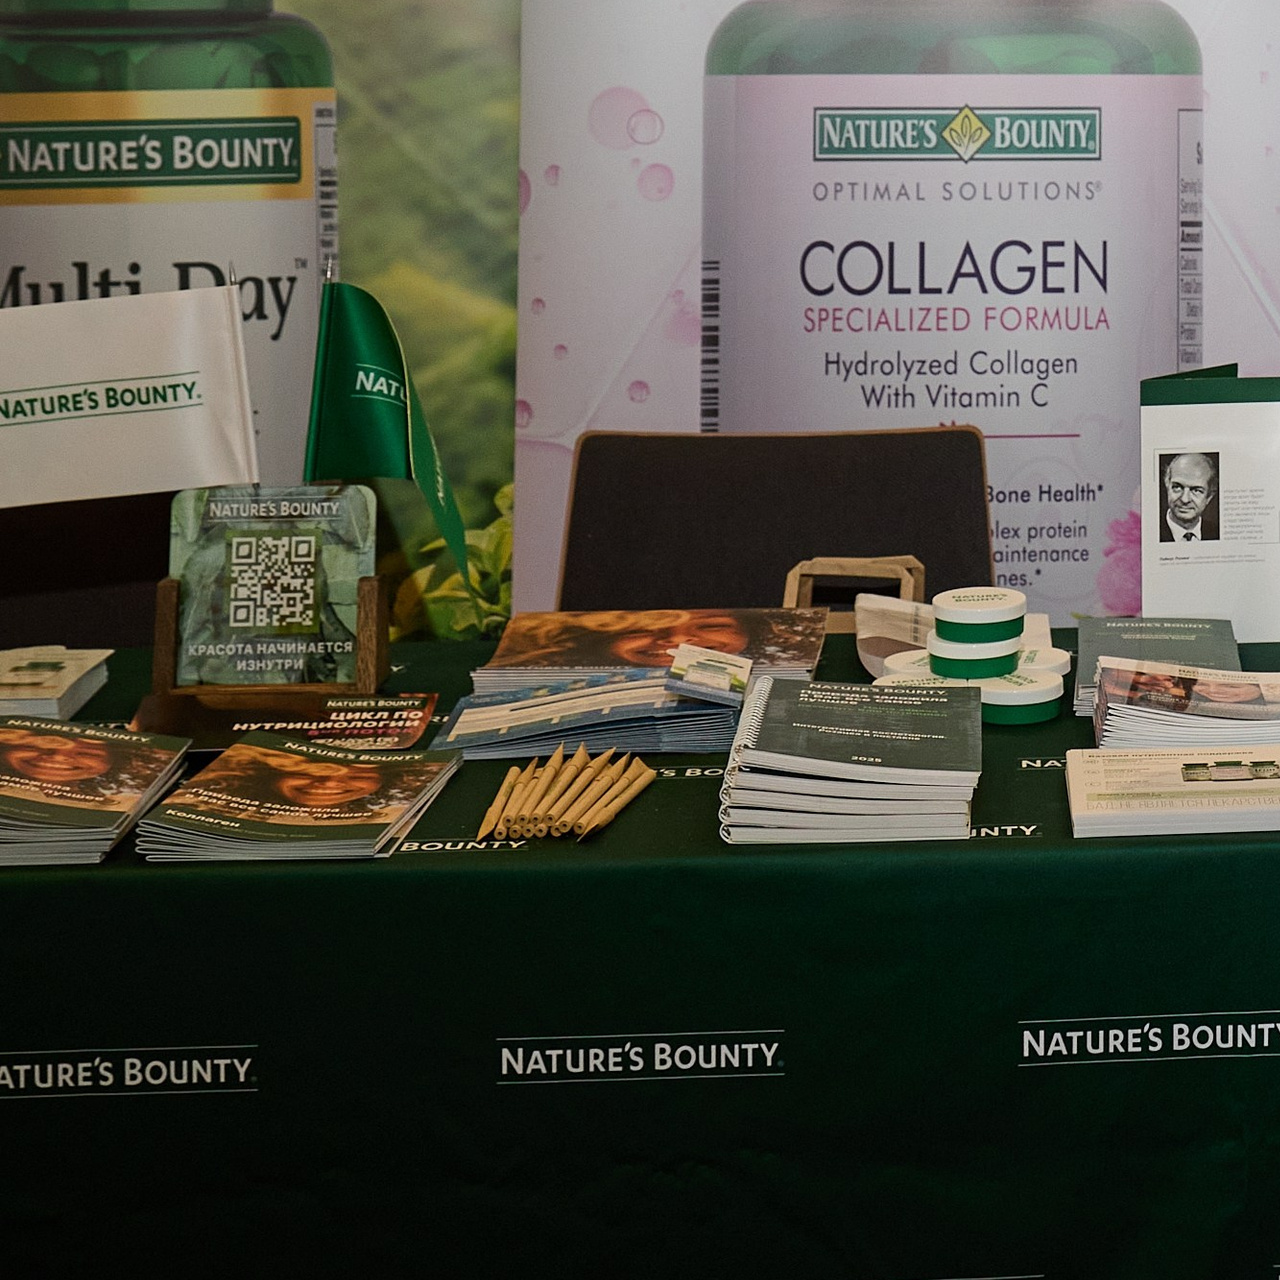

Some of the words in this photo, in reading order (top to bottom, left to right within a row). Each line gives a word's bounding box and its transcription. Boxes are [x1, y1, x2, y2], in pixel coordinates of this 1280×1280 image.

[822, 117, 938, 149] NATURE'S
[8, 134, 162, 173] NATURE'S
[813, 181, 926, 201] OPTIMAL
[800, 240, 1109, 297] COLLAGEN
[803, 306, 971, 334] SPECIALIZED
[984, 305, 1110, 332] FORMULA
[823, 350, 958, 382] Hydrolyzed
[969, 350, 1079, 381] Collagen
[0, 388, 98, 419] NATURE'S
[861, 384, 915, 410] With
[926, 382, 1021, 408] Vitamin
[1030, 383, 1049, 408] C
[987, 485, 1031, 503] Bone
[210, 500, 277, 519] NATURE'S
[280, 501, 340, 517] BOUNTY
[1027, 519, 1088, 543] protein
[188, 643, 254, 657] КРАСОТА
[256, 641, 354, 656] НАЧИНАЕТСЯ
[236, 658, 305, 672] ИЗНУТРИ
[809, 683, 879, 693] NATURE'S
[883, 687, 946, 696] BOUNTY
[326, 699, 375, 707] NATURE'S
[231, 719, 421, 732] НУТРИЦИОЛОГИИ
[329, 711, 390, 721] ЦИКЛ
[393, 710, 424, 720] ПО
[7, 719, 81, 734] NATURE'S
[83, 728, 151, 743] BOUNTY
[284, 741, 357, 761] NATURE'S
[359, 753, 424, 763] BOUNTY
[190, 788, 260, 806] Природа
[262, 802, 340, 814] заложила
[165, 808, 241, 828] Коллаген
[399, 840, 528, 852] BOUNTY
[1023, 1021, 1163, 1056] NATURE'S
[501, 1040, 645, 1075] NATURE'S
